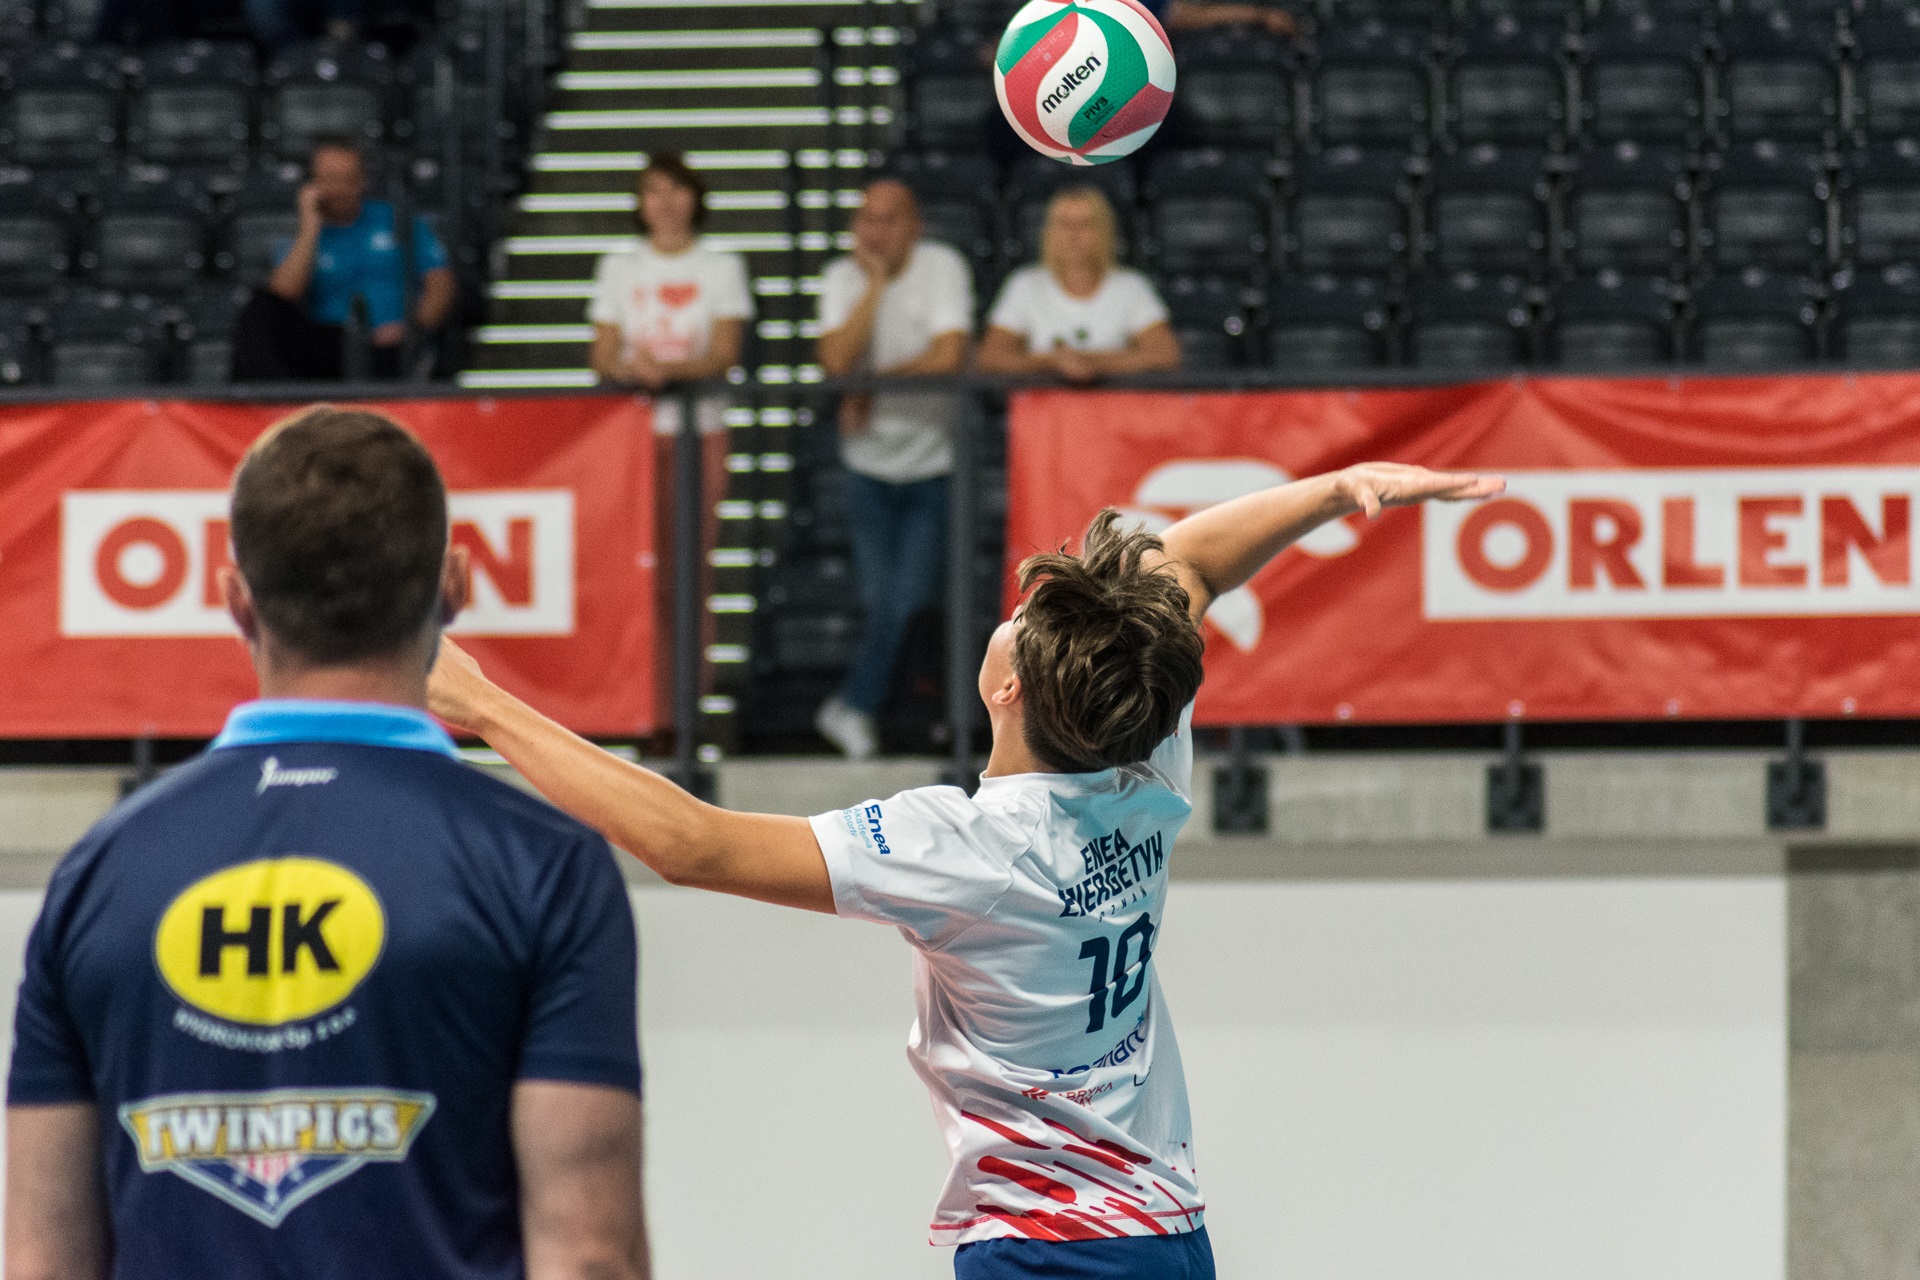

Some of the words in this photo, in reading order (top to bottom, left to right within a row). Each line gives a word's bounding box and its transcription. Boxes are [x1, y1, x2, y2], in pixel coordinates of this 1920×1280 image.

[1041, 55, 1102, 114] molten
[1454, 493, 1912, 591] ORLEN
[864, 804, 891, 855] Enea
[1080, 828, 1130, 875] ENEA
[197, 900, 343, 978] HK
[1077, 912, 1155, 1034] 10
[145, 1101, 400, 1159] TWINPIGS
